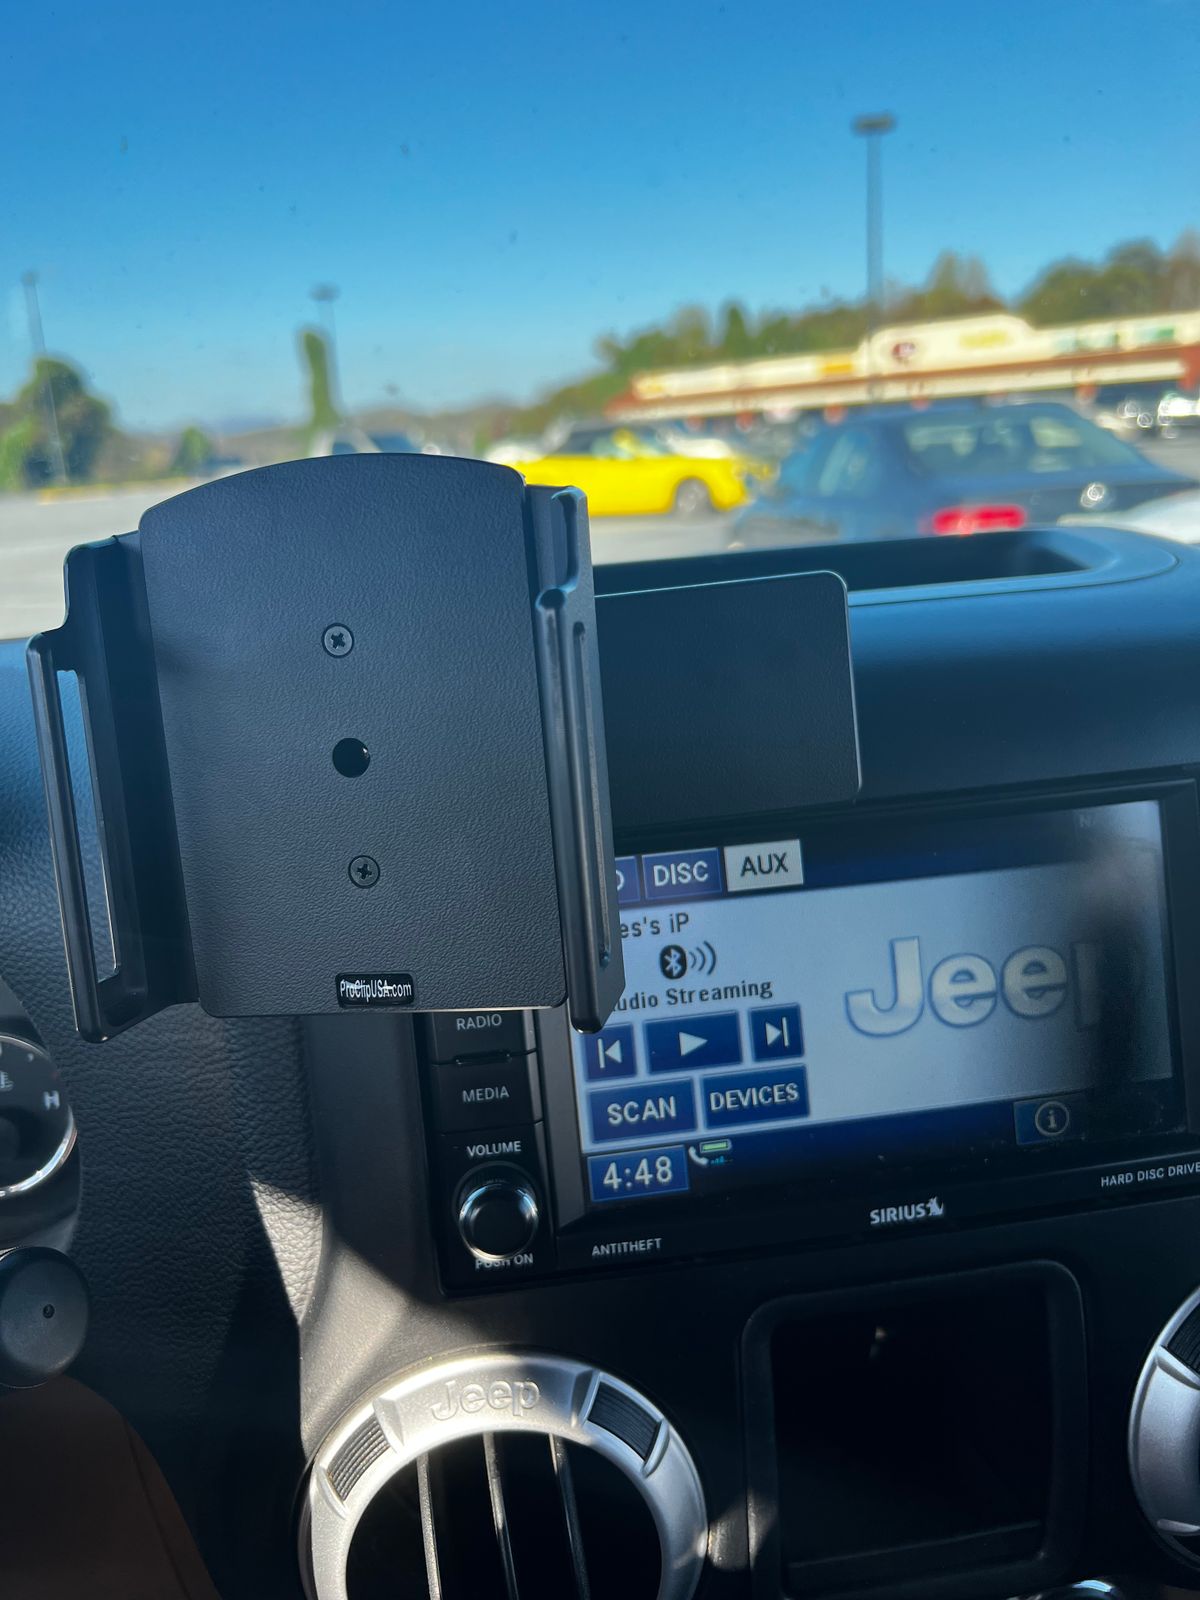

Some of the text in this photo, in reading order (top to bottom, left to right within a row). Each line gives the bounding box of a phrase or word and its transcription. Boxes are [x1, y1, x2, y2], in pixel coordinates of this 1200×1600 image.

[652, 860, 710, 888] DISC
[739, 851, 790, 878] AUX
[669, 912, 690, 934] iP
[340, 978, 413, 1003] ProClipUSA.com
[612, 980, 773, 1012] udio Streaming
[456, 1013, 503, 1031] RADIO
[43, 1090, 61, 1111] H
[462, 1085, 511, 1103] MEDIA
[709, 1082, 800, 1111] DEVICES
[606, 1096, 677, 1125] SCAN
[466, 1140, 522, 1158] VOLUME
[602, 1155, 674, 1191] 4:48
[1100, 1161, 1200, 1188] HARD DISC DRIVE
[869, 1202, 927, 1225] SIRIUS
[513, 1253, 534, 1266] ON
[591, 1237, 663, 1257] ANTITHEFT
[429, 1378, 540, 1422] Jeep
